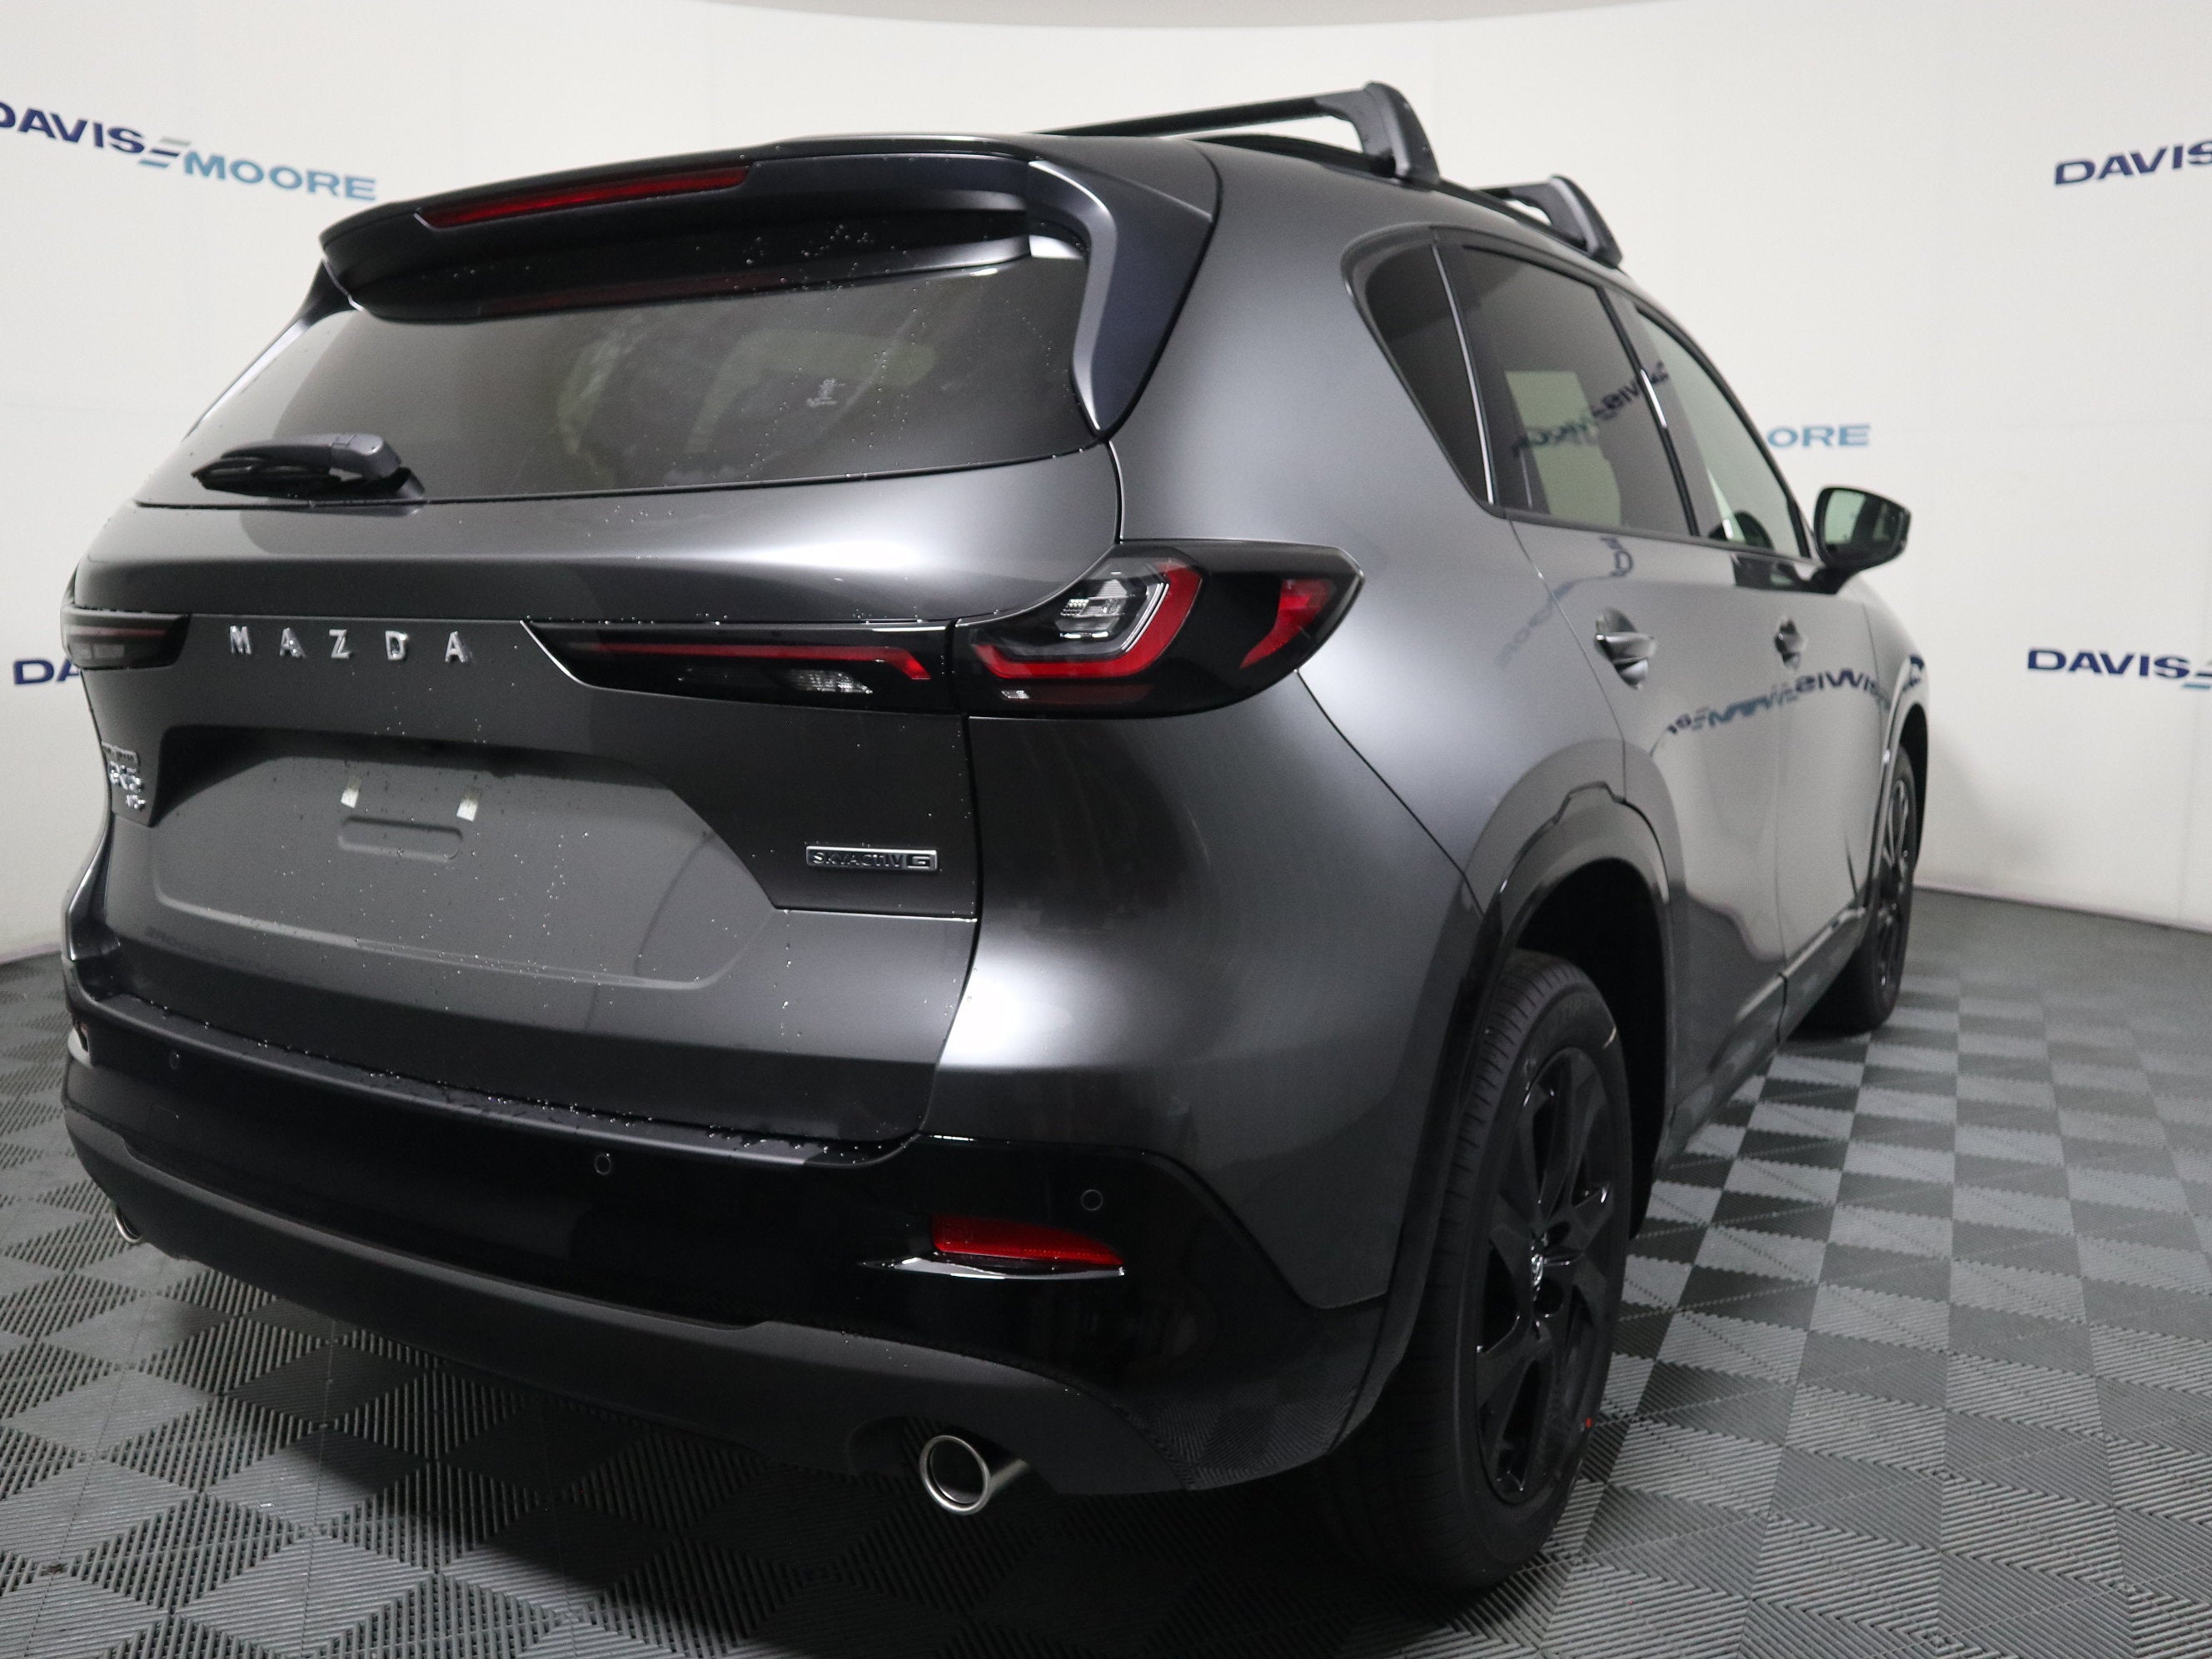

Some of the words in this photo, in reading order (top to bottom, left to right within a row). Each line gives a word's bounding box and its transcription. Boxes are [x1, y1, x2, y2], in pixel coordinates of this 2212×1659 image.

[182, 151, 376, 201] MOORE
[2054, 140, 2212, 186] DAVIS
[1767, 425, 1870, 447] ORE
[229, 625, 471, 663] MAZDA
[2027, 648, 2190, 678] DAVIS
